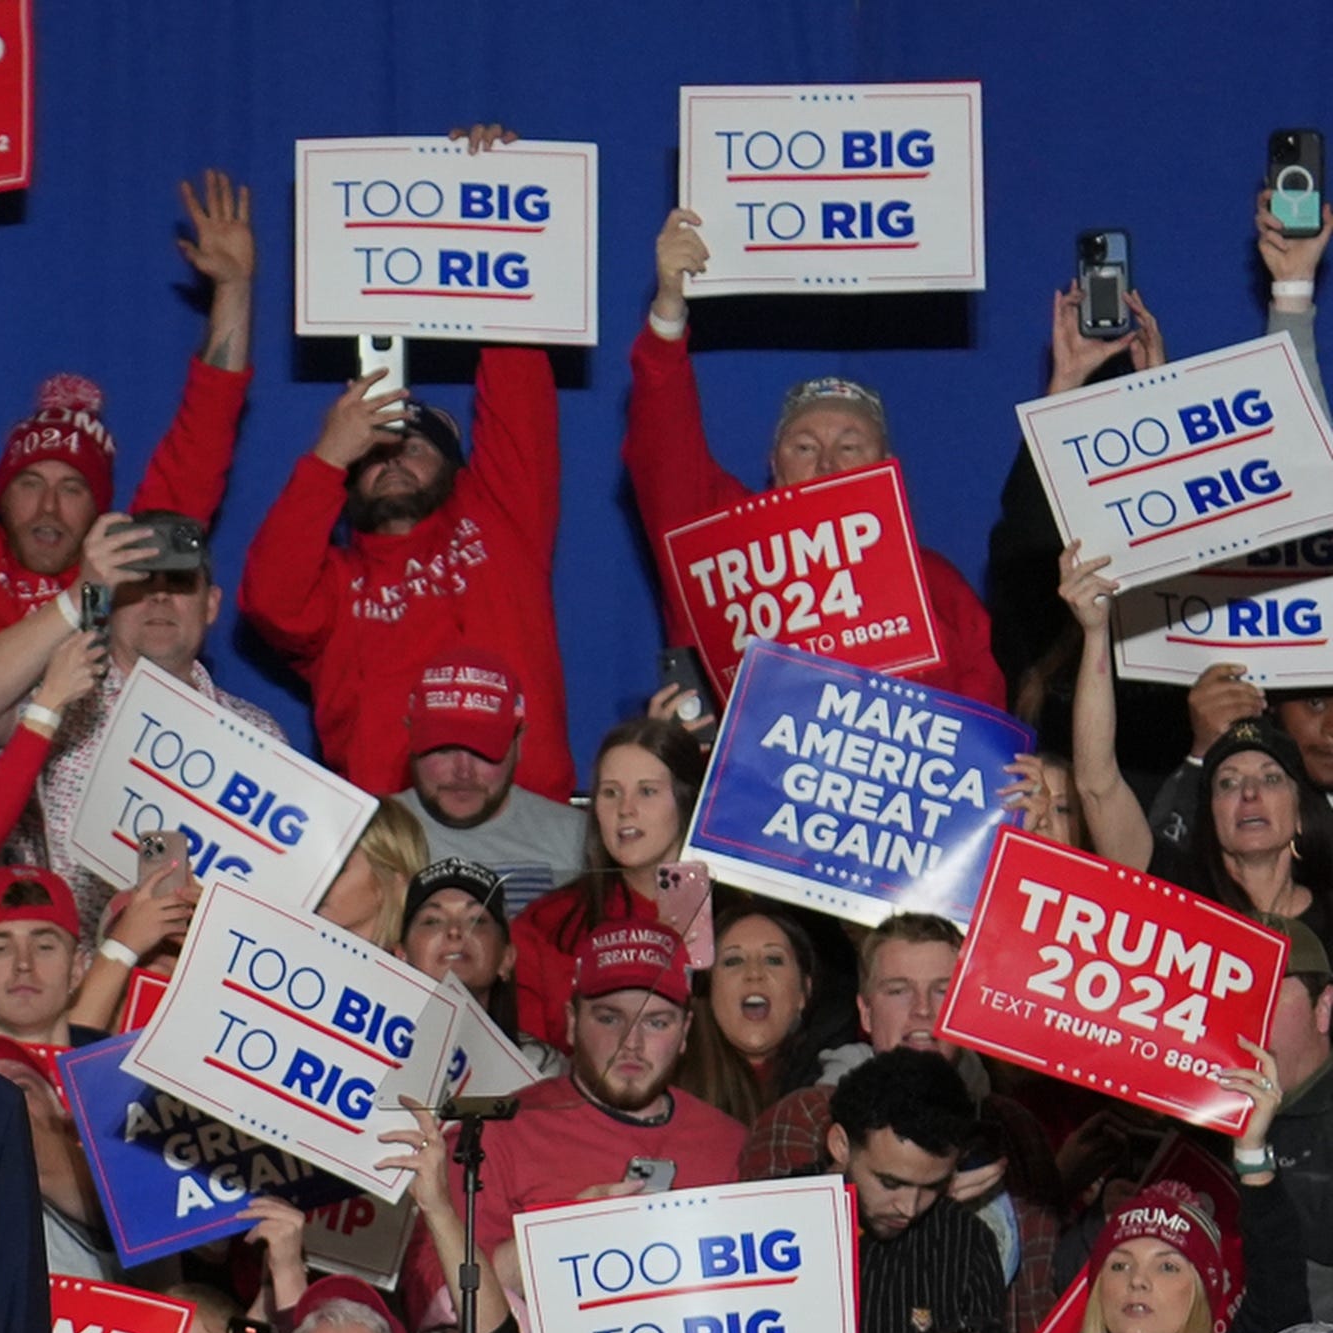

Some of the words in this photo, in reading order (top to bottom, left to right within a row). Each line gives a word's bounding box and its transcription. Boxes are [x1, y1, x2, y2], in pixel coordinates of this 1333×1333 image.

[715, 130, 825, 170] TOO
[842, 128, 934, 170] BIG
[333, 179, 443, 218] TOO
[460, 180, 551, 223] BIG
[736, 202, 806, 241] TO
[821, 200, 915, 240] RIG
[353, 247, 423, 284] TO
[438, 249, 530, 290] RIG
[1062, 416, 1170, 475] TOO
[1177, 387, 1274, 447] BIG
[1106, 490, 1177, 538] TO
[1183, 457, 1285, 516] RIG
[689, 510, 882, 607] TRUMP
[723, 569, 863, 652] 2024
[806, 632, 836, 654] TO
[840, 615, 910, 646] 88022
[1155, 592, 1213, 635] TO
[1227, 598, 1322, 637] RIG
[817, 682, 963, 758] MAKE
[128, 712, 216, 789] TOO
[216, 770, 310, 848] BIG
[760, 714, 986, 810] AMERICA
[124, 786, 163, 838] TO
[782, 763, 951, 839] GREAT
[762, 803, 942, 878] AGAIN!
[1017, 878, 1255, 1003] TRUMP
[222, 928, 326, 1011] TOO
[332, 987, 418, 1060] BIG
[979, 985, 1038, 1018] TEXT
[1043, 1007, 1122, 1049] TRUMP
[1129, 1034, 1157, 1062] TO
[1026, 947, 1207, 1045] 2024
[215, 1010, 277, 1073] TO
[281, 1048, 377, 1120] RIG
[1118, 1207, 1191, 1233] TRUMP
[558, 1242, 681, 1296] TOO
[699, 1230, 802, 1279] BIG
